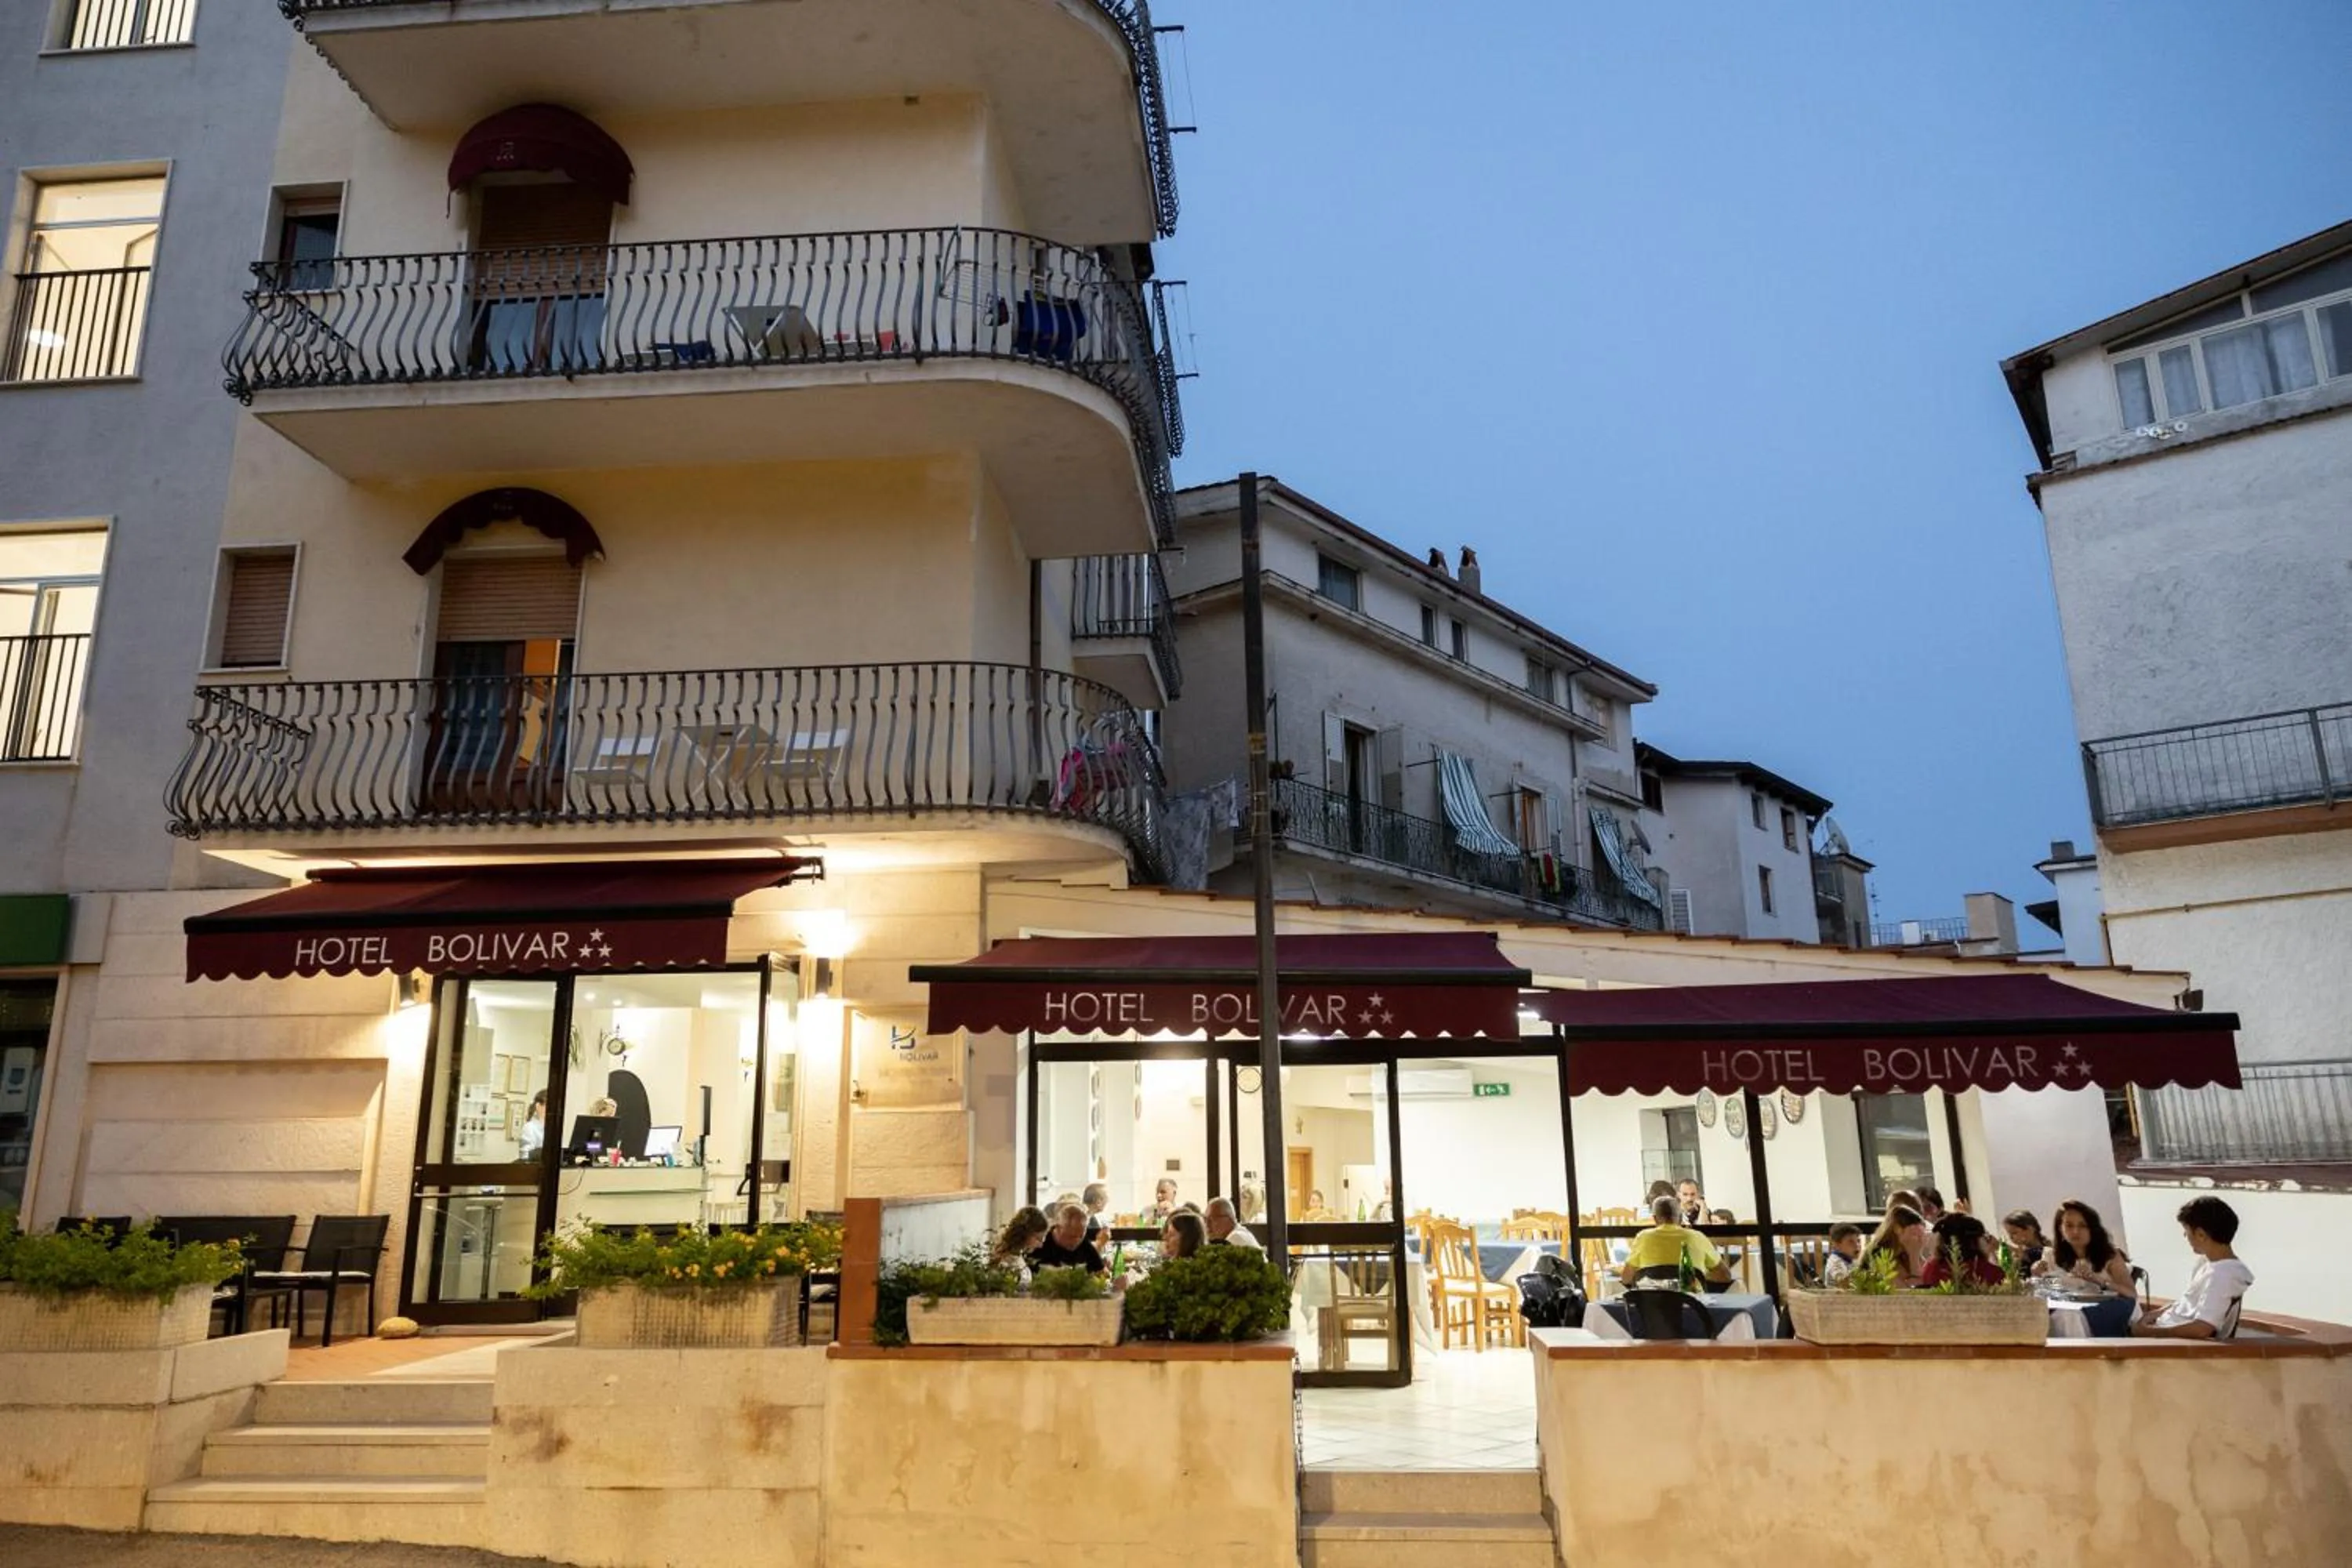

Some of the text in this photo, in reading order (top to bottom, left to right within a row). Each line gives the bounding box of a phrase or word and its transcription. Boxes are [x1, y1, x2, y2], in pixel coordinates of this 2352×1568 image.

[295, 931, 569, 966] HOTEL BOLIVAR
[1045, 992, 1347, 1024] HOTEL BOLVAR
[1702, 1046, 2038, 1081] HOTEL BOLIVAR
